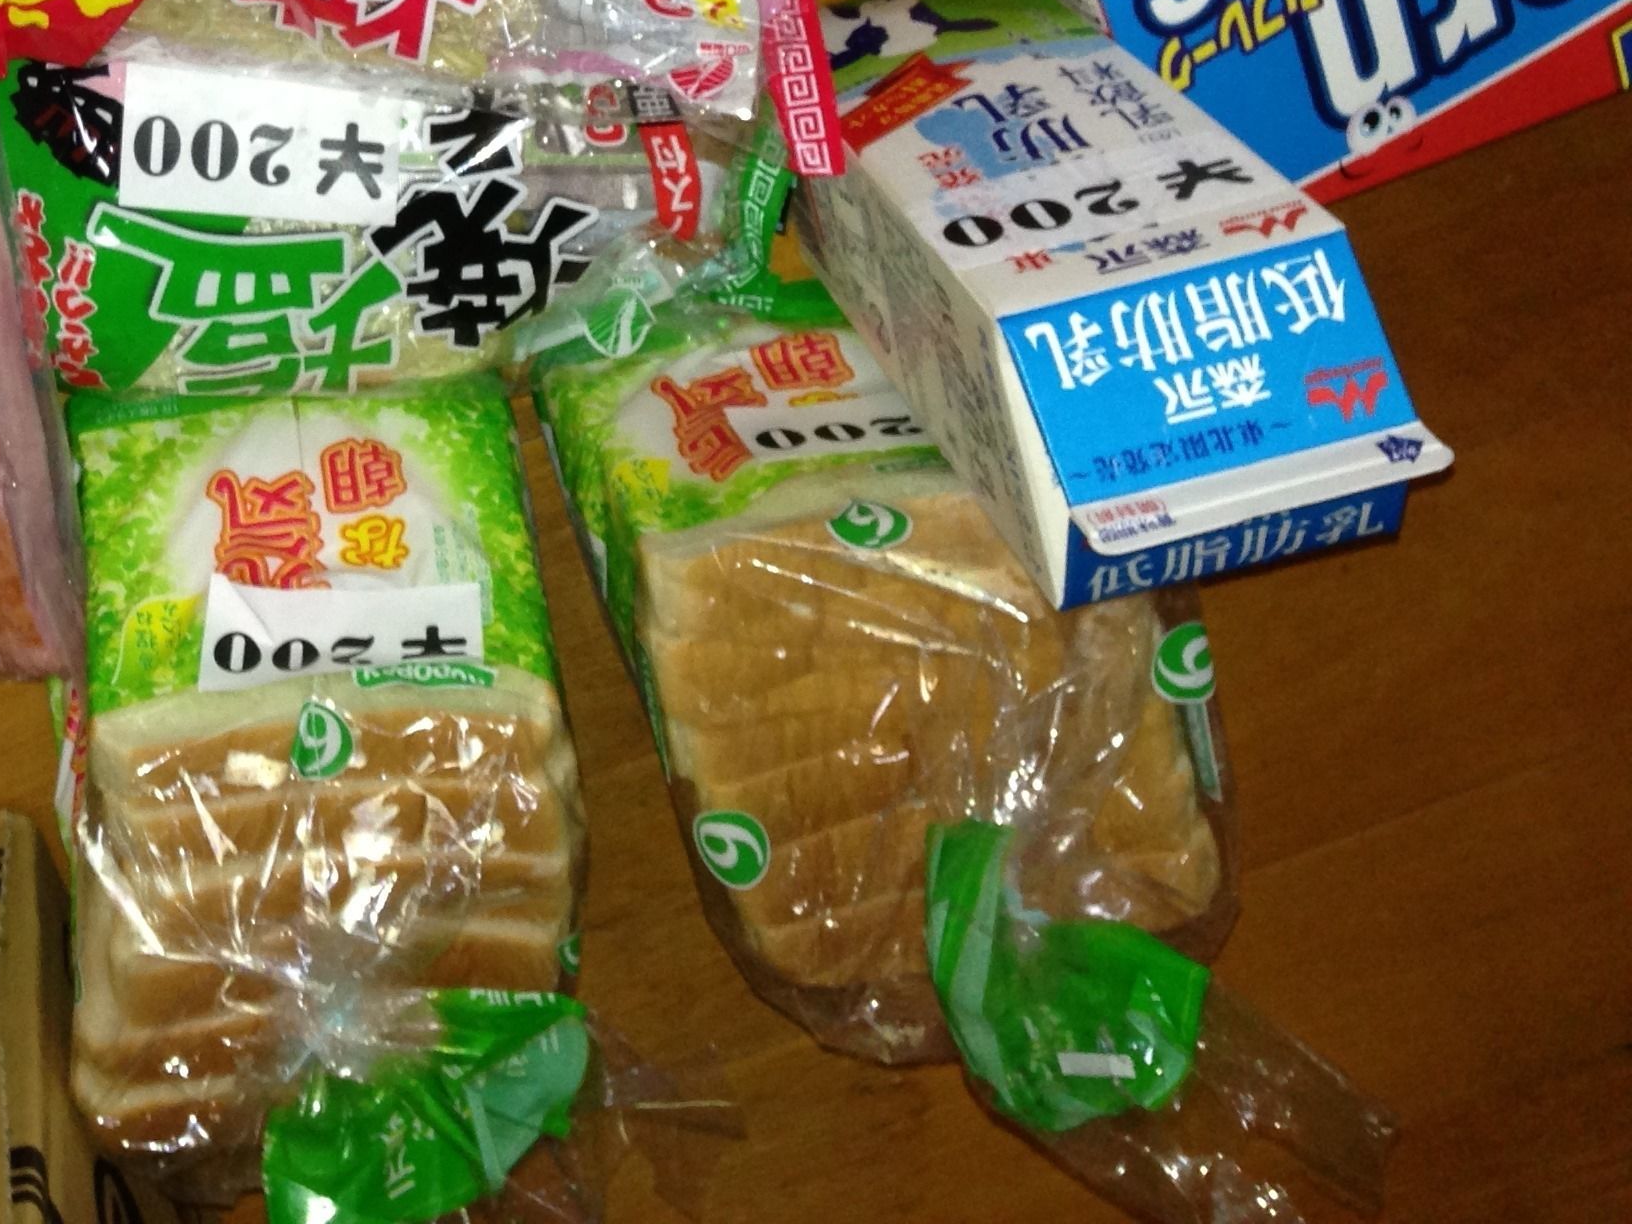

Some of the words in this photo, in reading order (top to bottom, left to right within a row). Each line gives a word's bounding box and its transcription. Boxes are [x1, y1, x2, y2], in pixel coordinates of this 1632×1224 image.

[131, 115, 384, 201] ¥200
[941, 157, 1253, 248] ¥200
[1084, 226, 1209, 275] 森永
[1022, 247, 1346, 389] 低脂肪乳
[1152, 352, 1271, 423] 森永
[754, 415, 922, 451] 200
